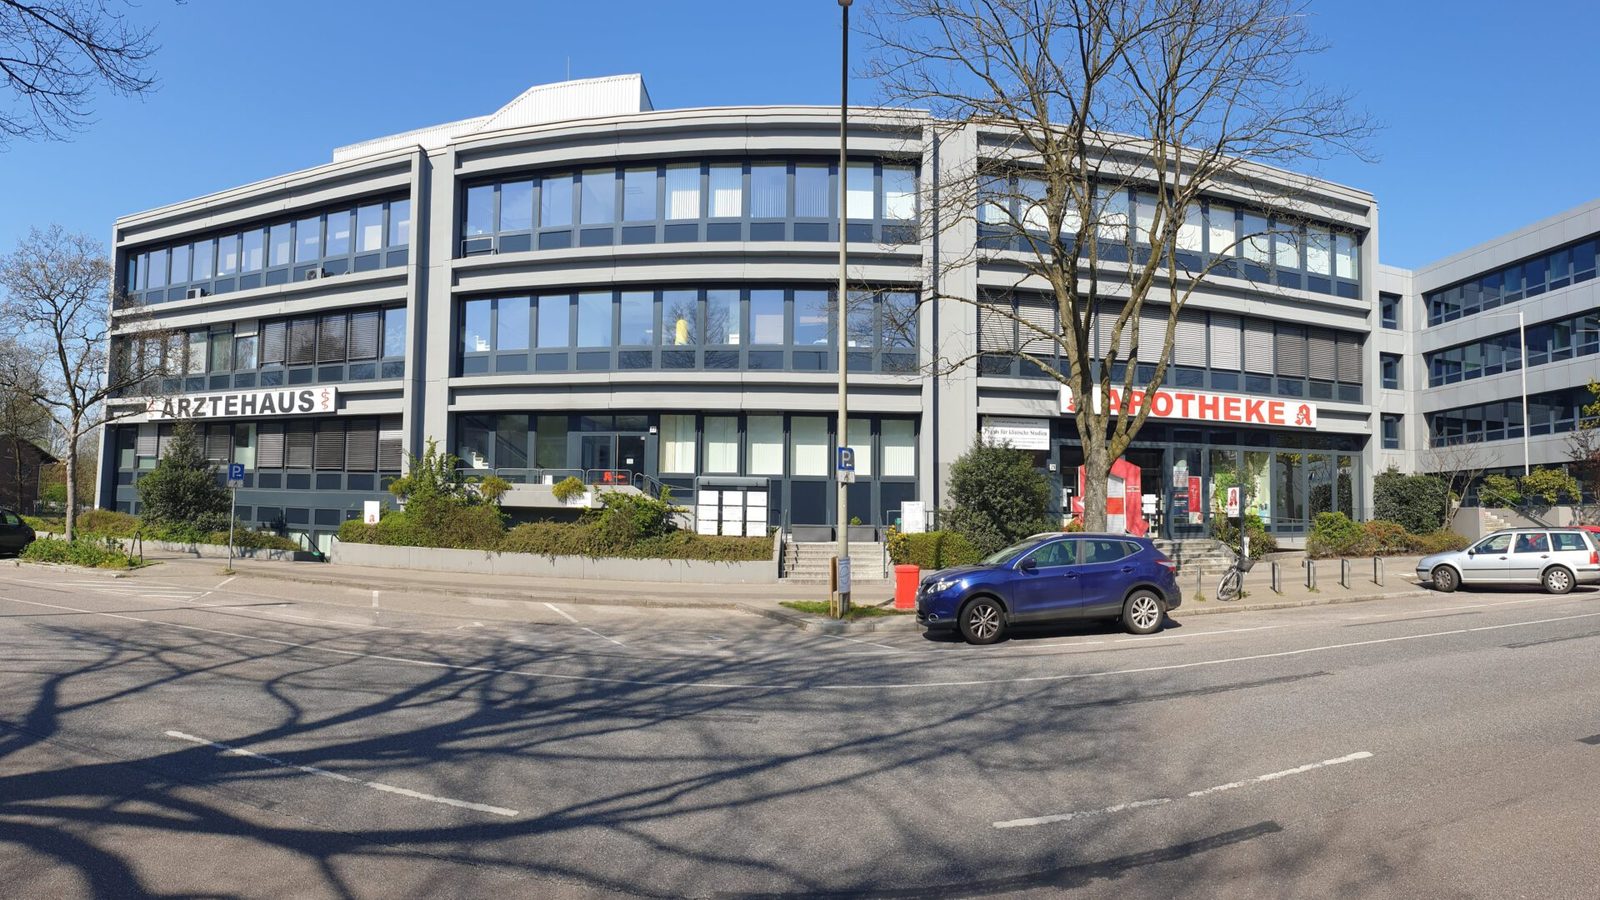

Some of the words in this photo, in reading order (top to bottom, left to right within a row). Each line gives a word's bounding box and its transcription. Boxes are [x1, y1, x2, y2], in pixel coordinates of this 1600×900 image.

[1108, 389, 1286, 425] APOTHEKE
[841, 450, 851, 467] P
[231, 465, 241, 478] P
